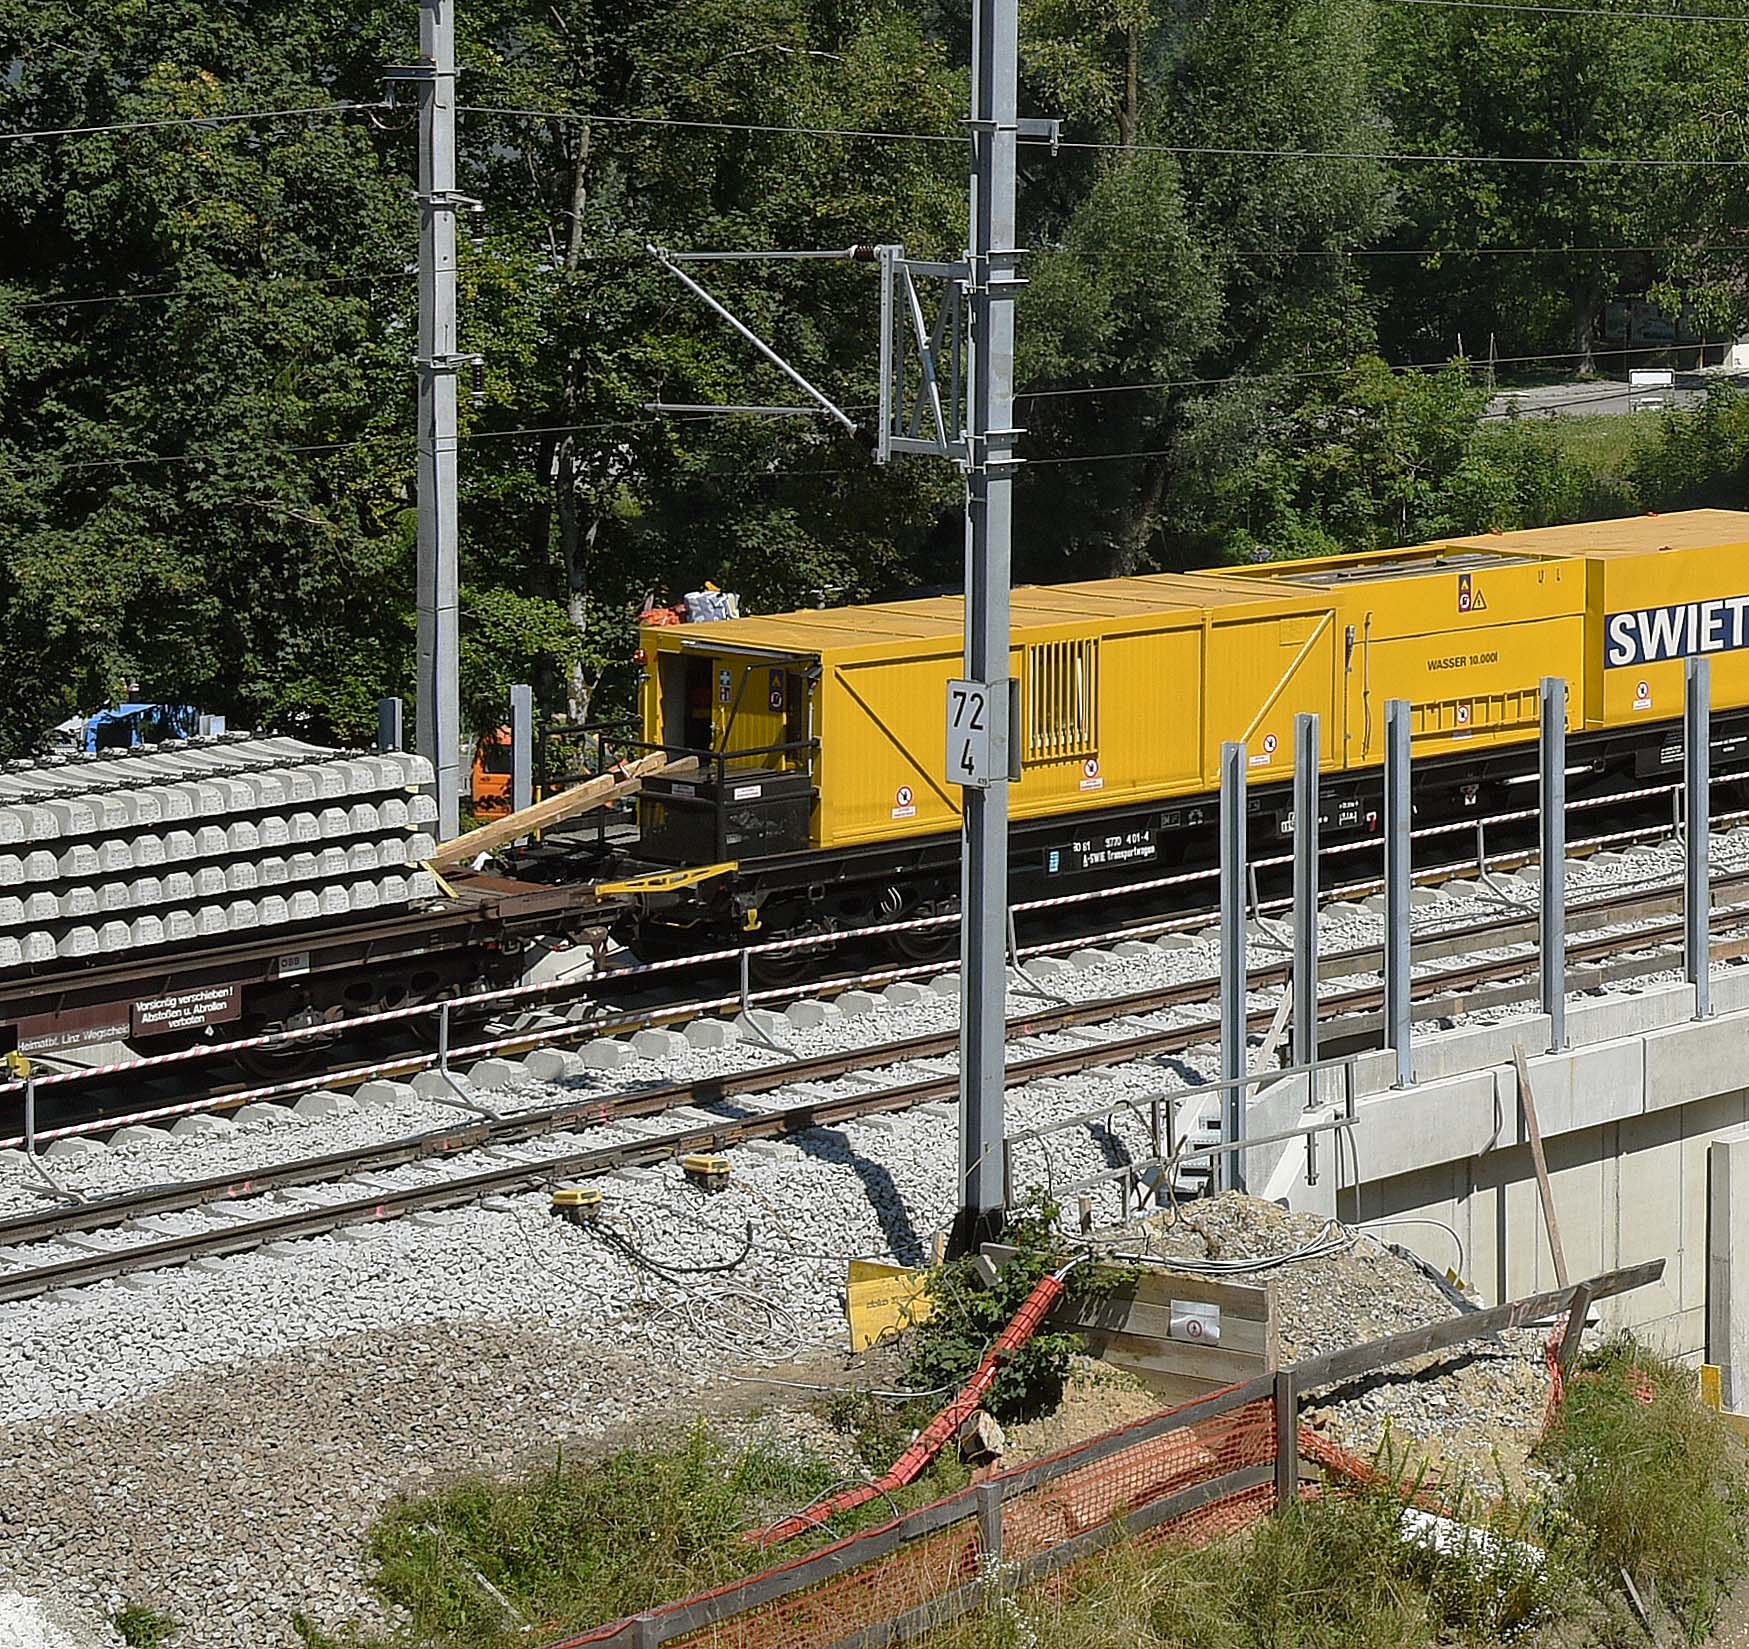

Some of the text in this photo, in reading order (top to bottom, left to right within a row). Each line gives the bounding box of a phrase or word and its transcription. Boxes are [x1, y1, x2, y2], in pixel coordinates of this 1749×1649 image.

[1427, 656, 1467, 671] WASSER
[952, 690, 984, 730] 72
[960, 739, 974, 776] 4
[1106, 845, 1156, 861] Transportwagen
[136, 997, 176, 1012] Vorsichtig
[178, 989, 228, 1004] verschieben
[141, 1008, 182, 1024] Abstoßen
[193, 1001, 227, 1014] Abrollen
[168, 1015, 205, 1028] verboten
[61, 1034, 80, 1044] Linz
